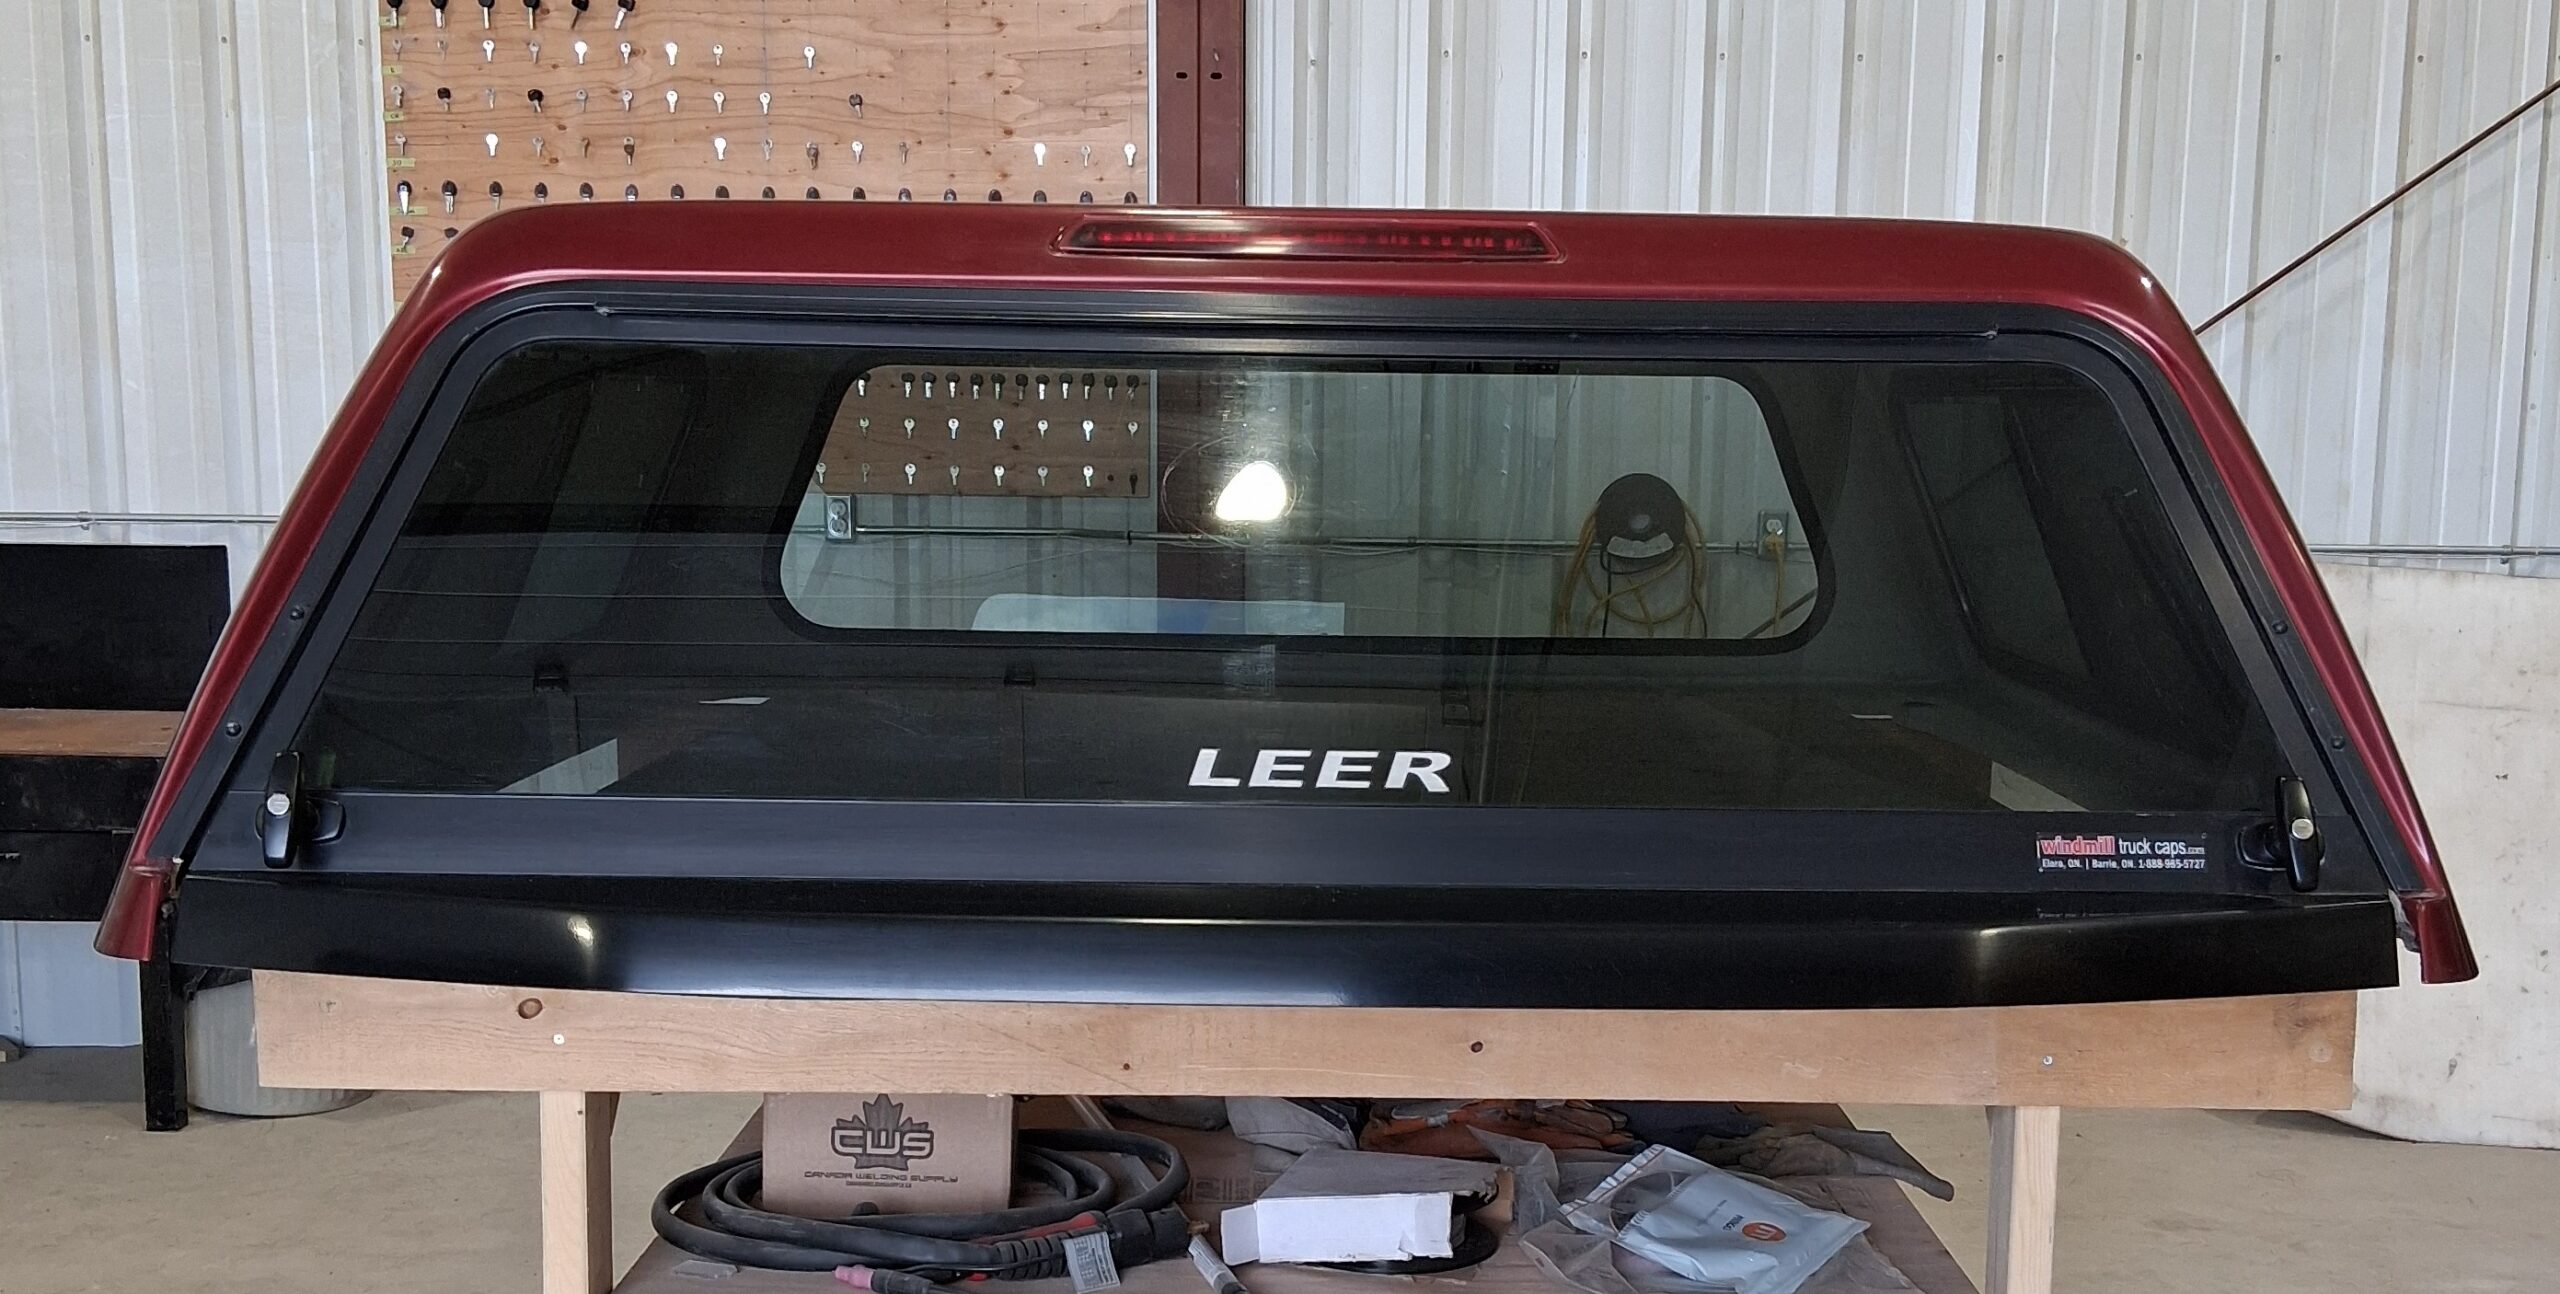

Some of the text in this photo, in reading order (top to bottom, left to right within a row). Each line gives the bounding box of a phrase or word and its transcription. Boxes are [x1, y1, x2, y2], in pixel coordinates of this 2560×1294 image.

[1188, 748, 1452, 792] LEER
[2040, 835, 2115, 855] windmill
[2118, 837, 2152, 854] truck
[833, 1129, 932, 1157] CWS
[804, 1171, 958, 1183] CANADA WELDING SUPPLY
